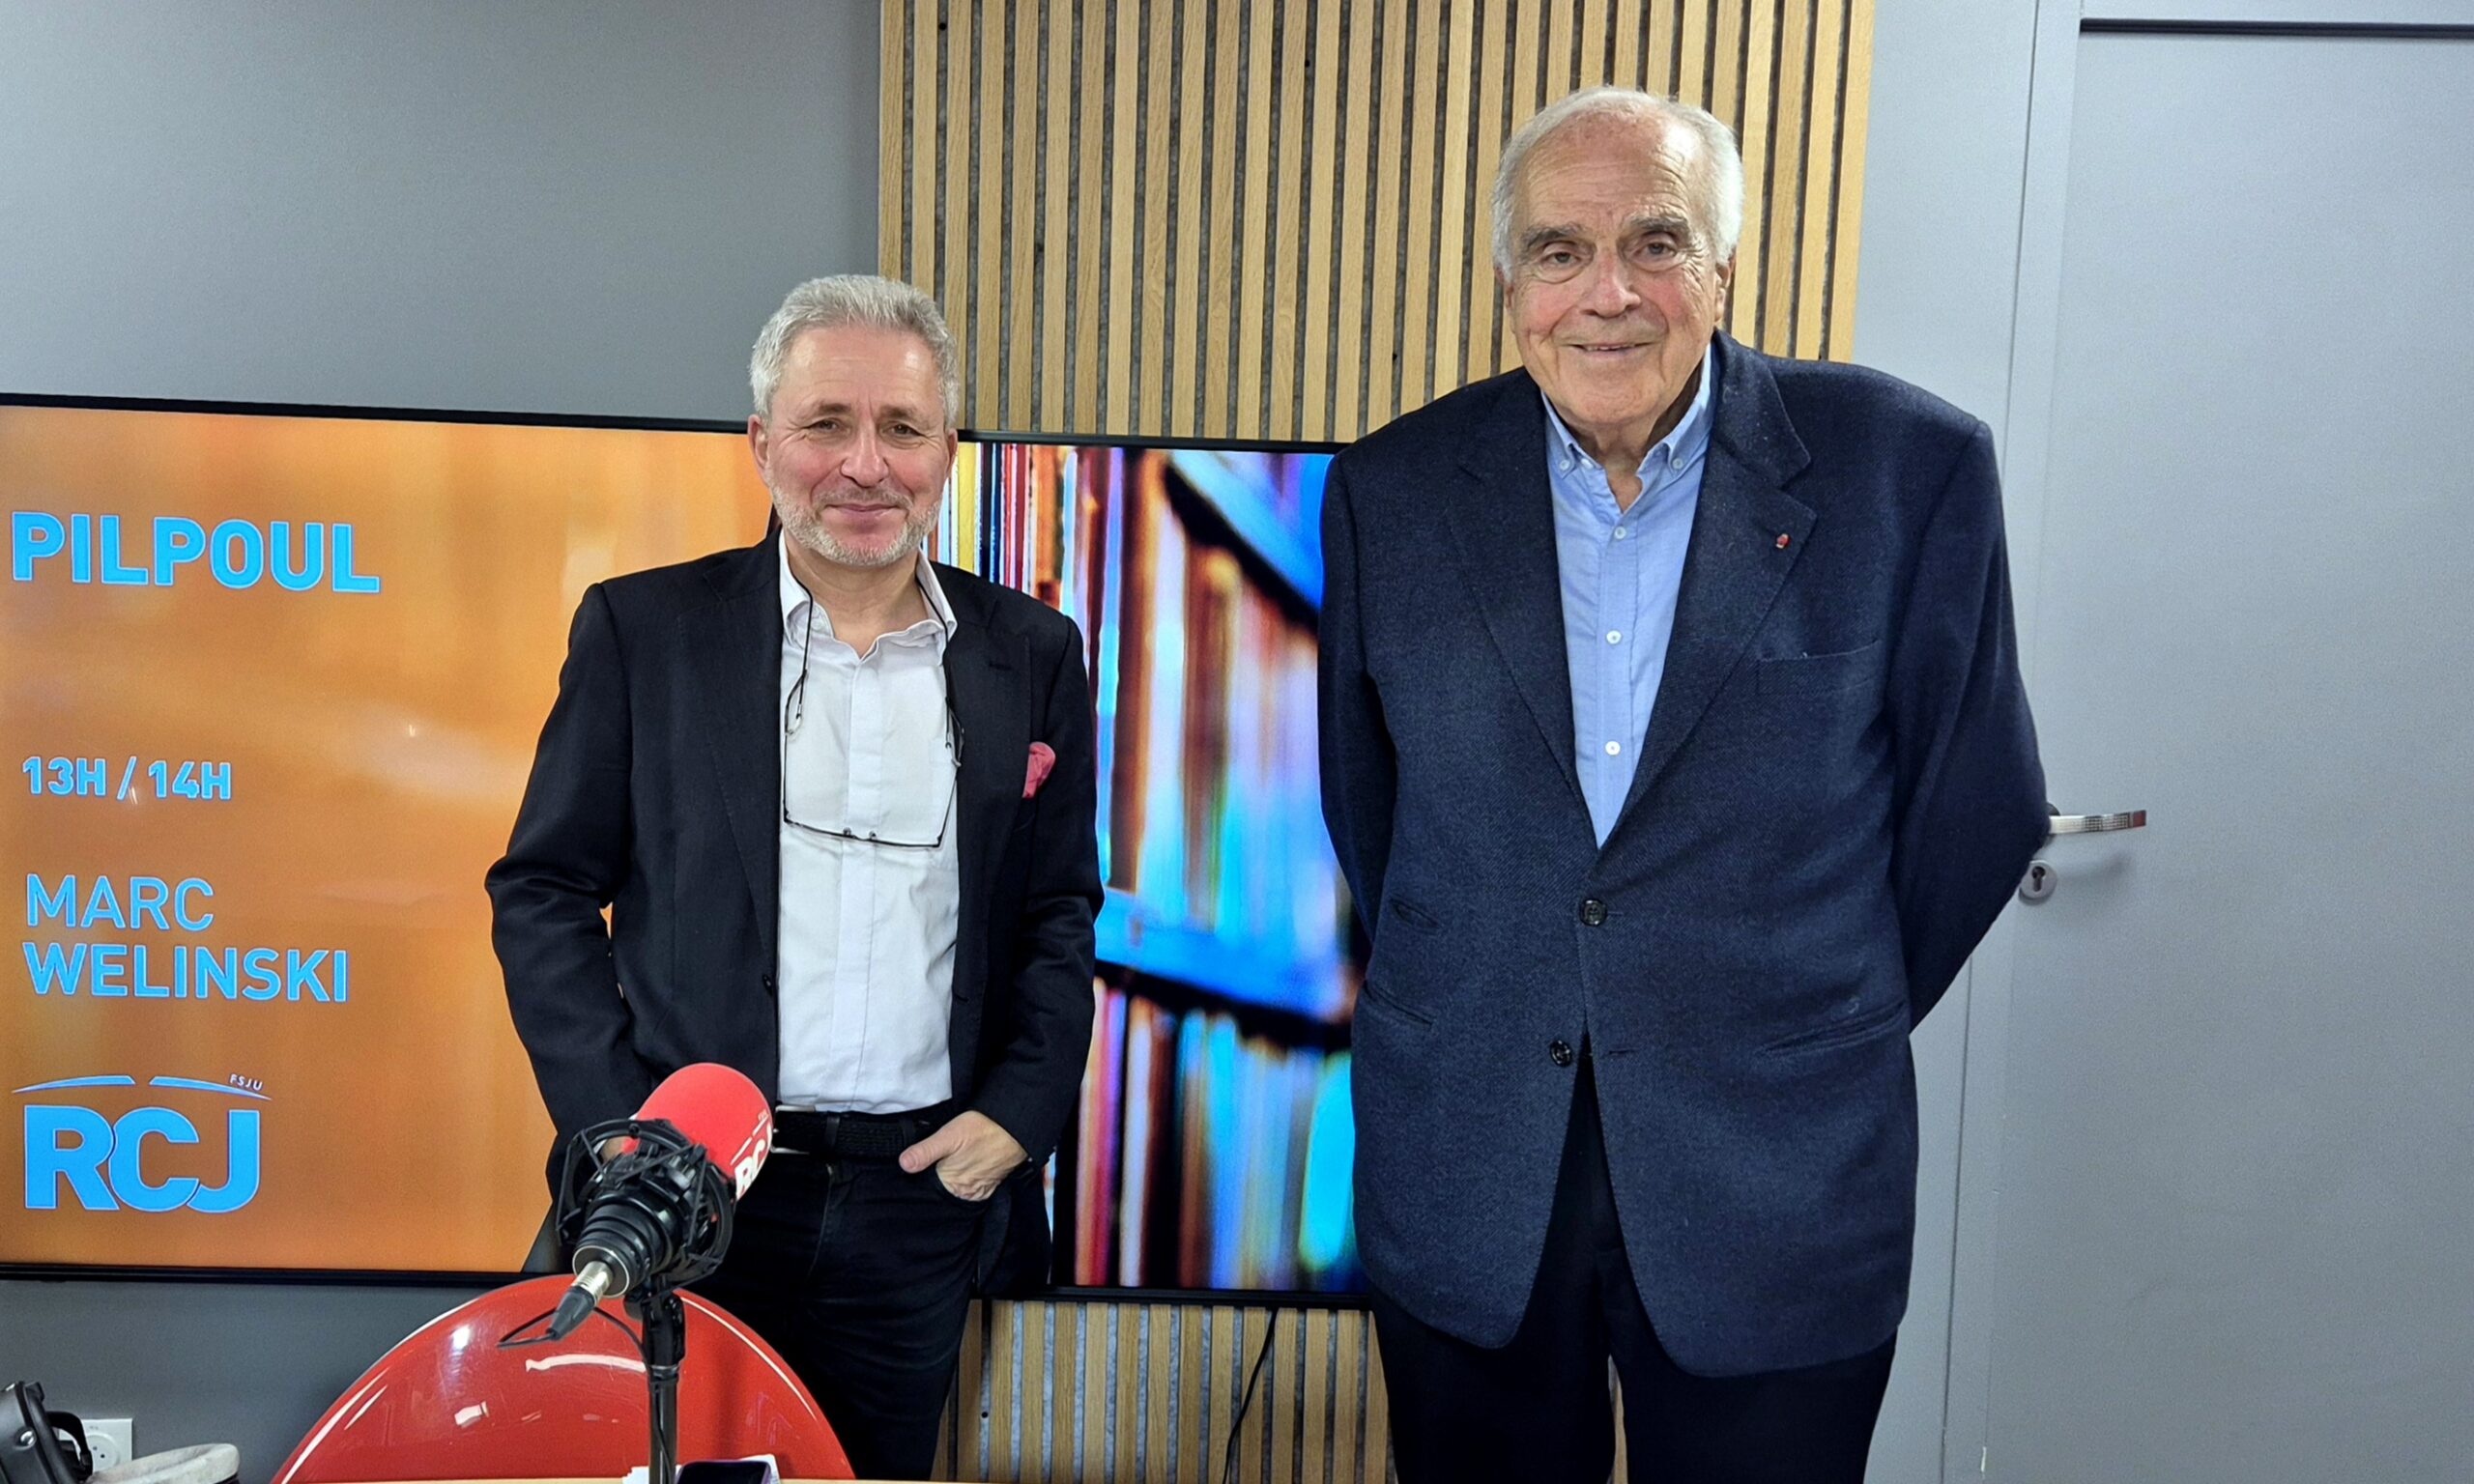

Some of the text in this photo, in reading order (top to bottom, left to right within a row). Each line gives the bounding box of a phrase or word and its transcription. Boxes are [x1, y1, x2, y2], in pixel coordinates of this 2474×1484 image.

[12, 511, 380, 593] PILPOUL
[22, 756, 106, 796] 13H
[148, 759, 231, 800] 14H
[26, 873, 215, 931] MARC
[22, 942, 348, 1003] WELINSKI
[229, 1073, 263, 1091] FSJU
[24, 1104, 261, 1213] RCJ
